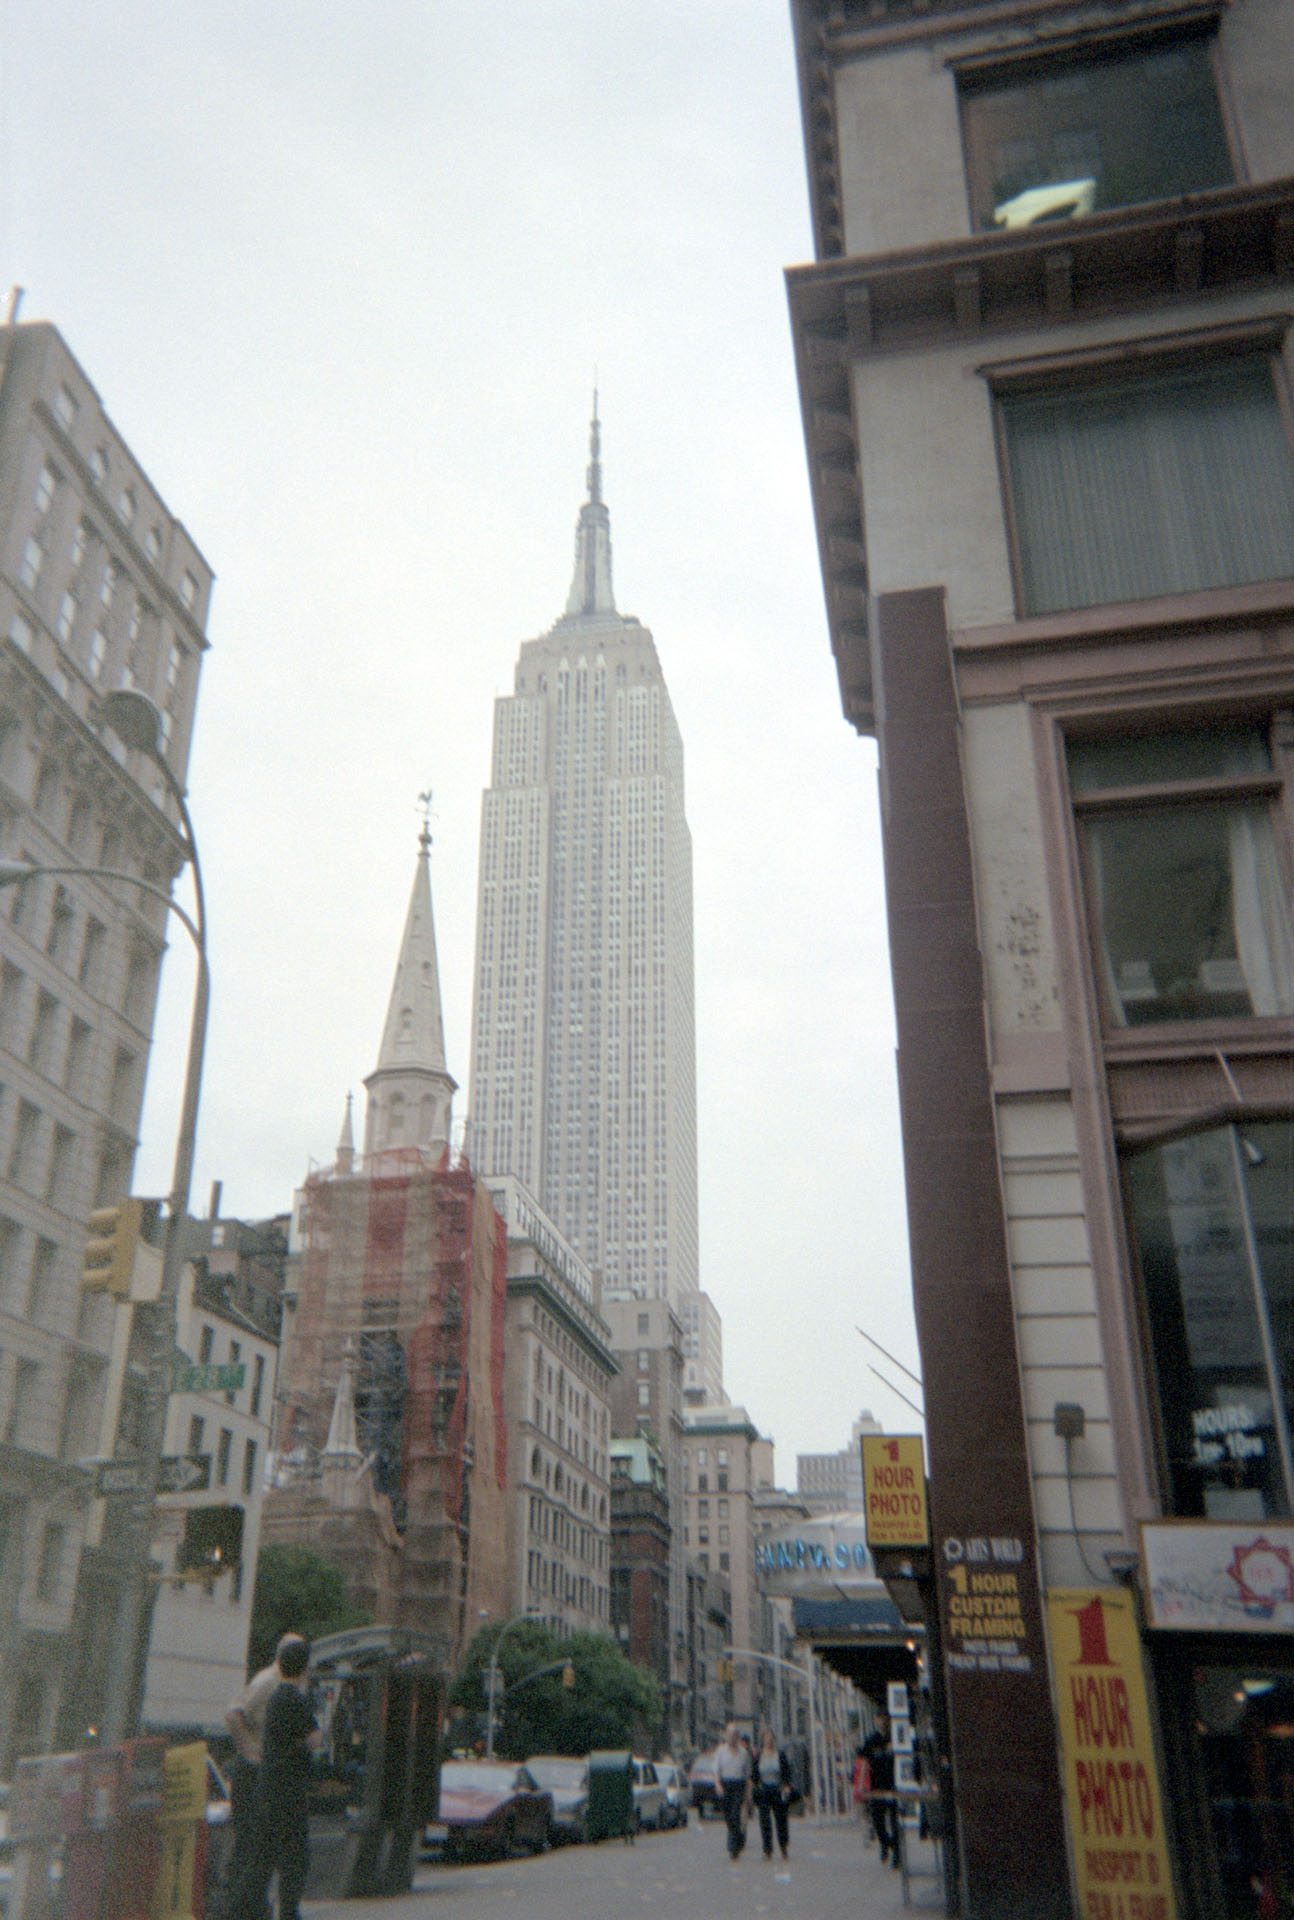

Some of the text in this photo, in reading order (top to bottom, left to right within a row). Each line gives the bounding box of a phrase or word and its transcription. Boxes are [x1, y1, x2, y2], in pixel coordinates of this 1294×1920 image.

[882, 1440, 899, 1462] 1
[873, 1465, 915, 1488] HOUR
[869, 1492, 921, 1516] PHOTO
[947, 1564, 1018, 1594] 1 HOUR
[949, 1596, 1021, 1617] CUSTOM
[949, 1616, 1026, 1638] FRAMING
[1064, 1596, 1121, 1666] 1
[1070, 1675, 1135, 1749] HOUR
[1076, 1759, 1154, 1839] PHOTO
